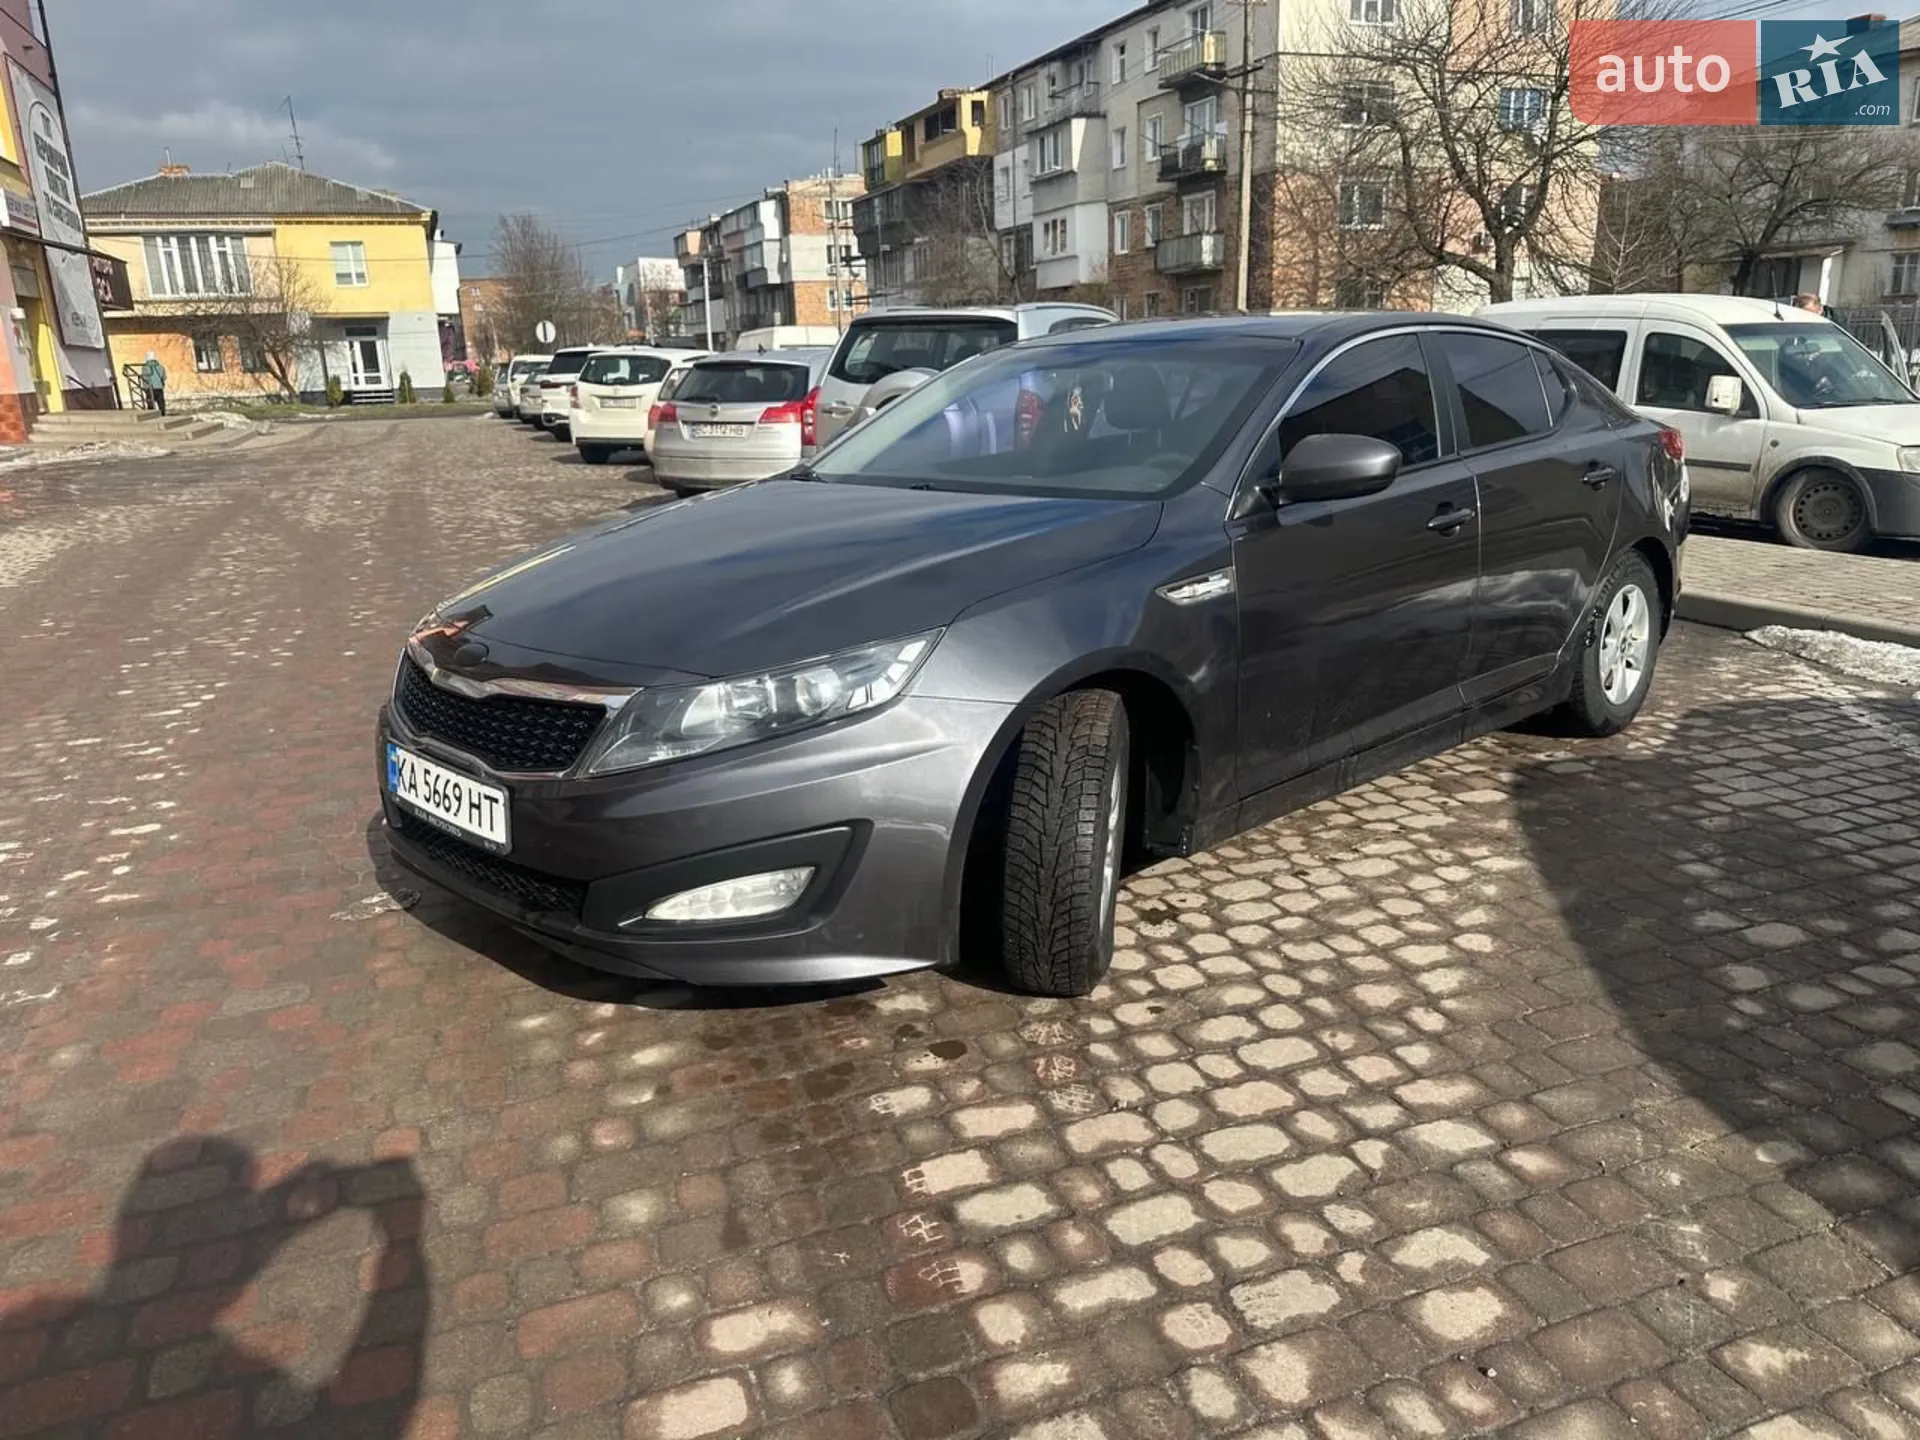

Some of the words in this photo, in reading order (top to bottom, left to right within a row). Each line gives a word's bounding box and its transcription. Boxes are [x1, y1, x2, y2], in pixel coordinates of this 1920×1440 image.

[397, 757, 418, 798] KA
[423, 770, 463, 817] 5669
[468, 787, 499, 833] HT
